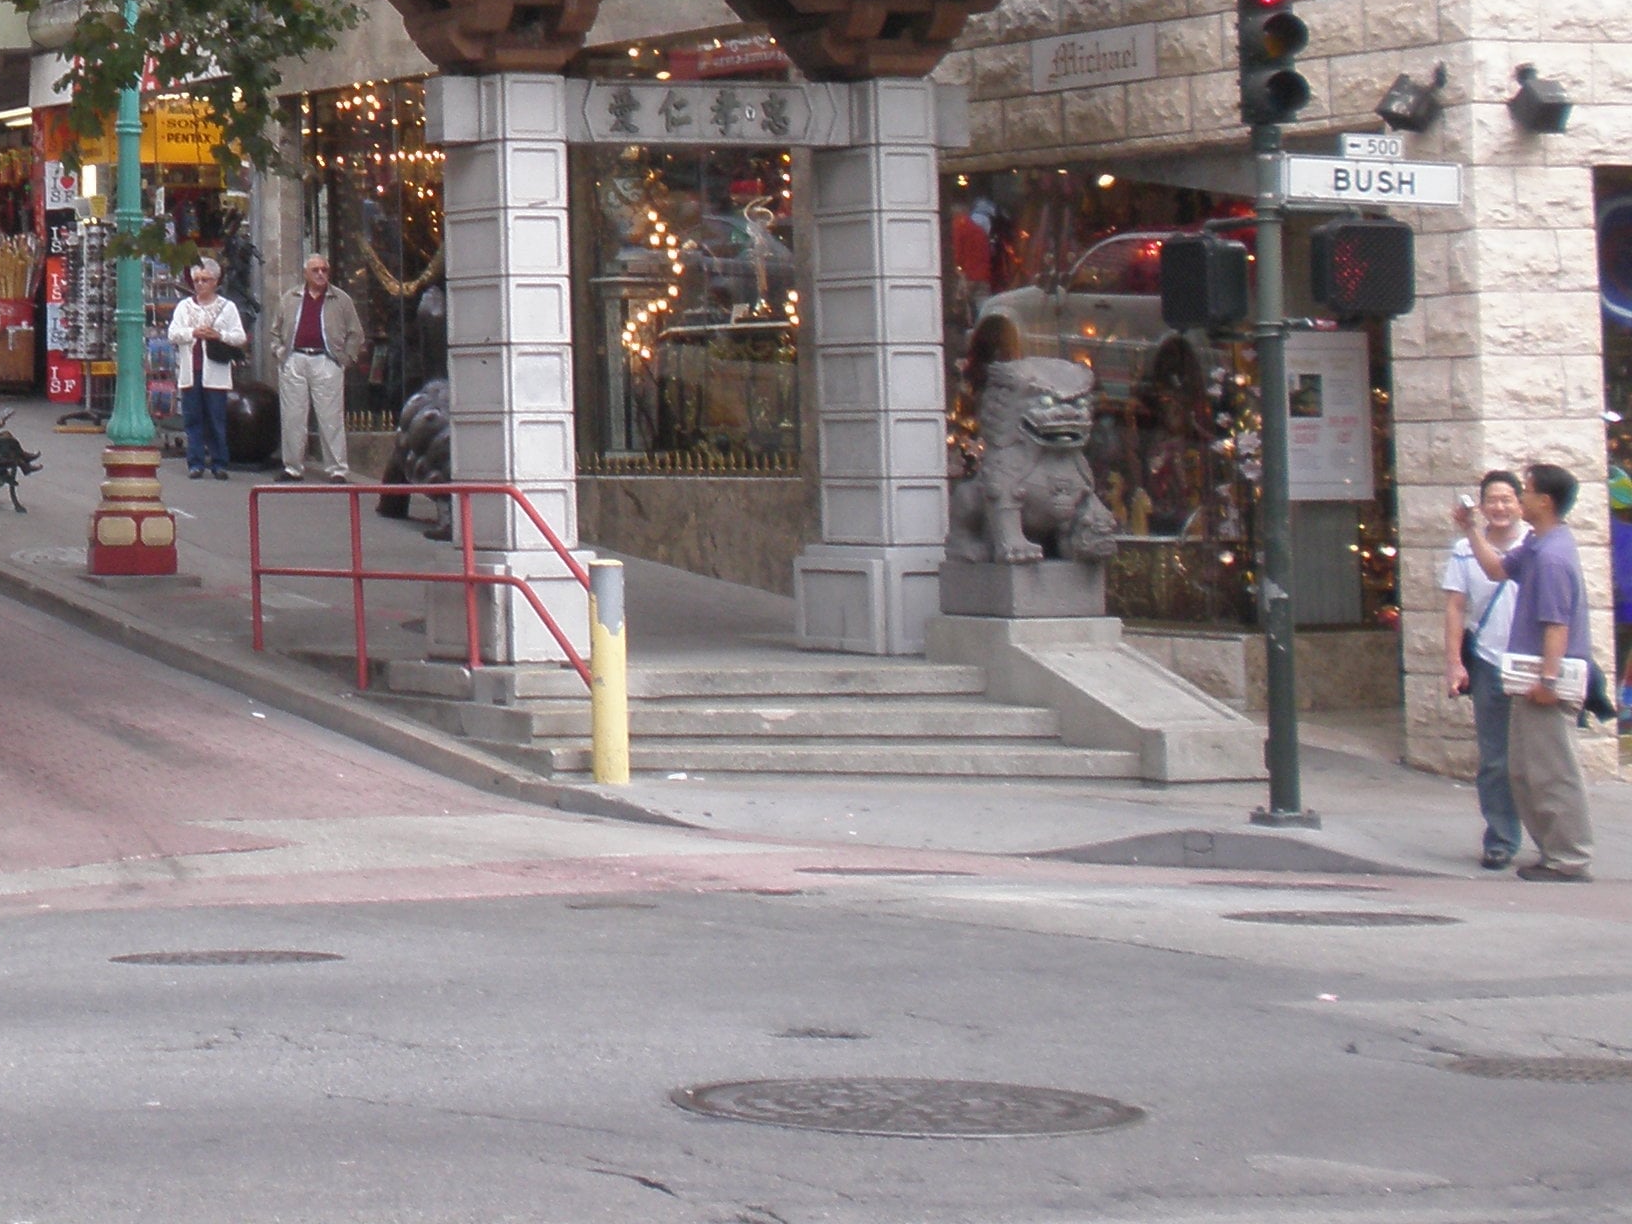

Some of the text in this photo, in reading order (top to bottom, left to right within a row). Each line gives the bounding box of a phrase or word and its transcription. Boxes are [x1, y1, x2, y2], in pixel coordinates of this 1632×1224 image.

[167, 133, 213, 144] PENTAX
[1367, 140, 1400, 155] 500
[1333, 168, 1415, 195] BUSH
